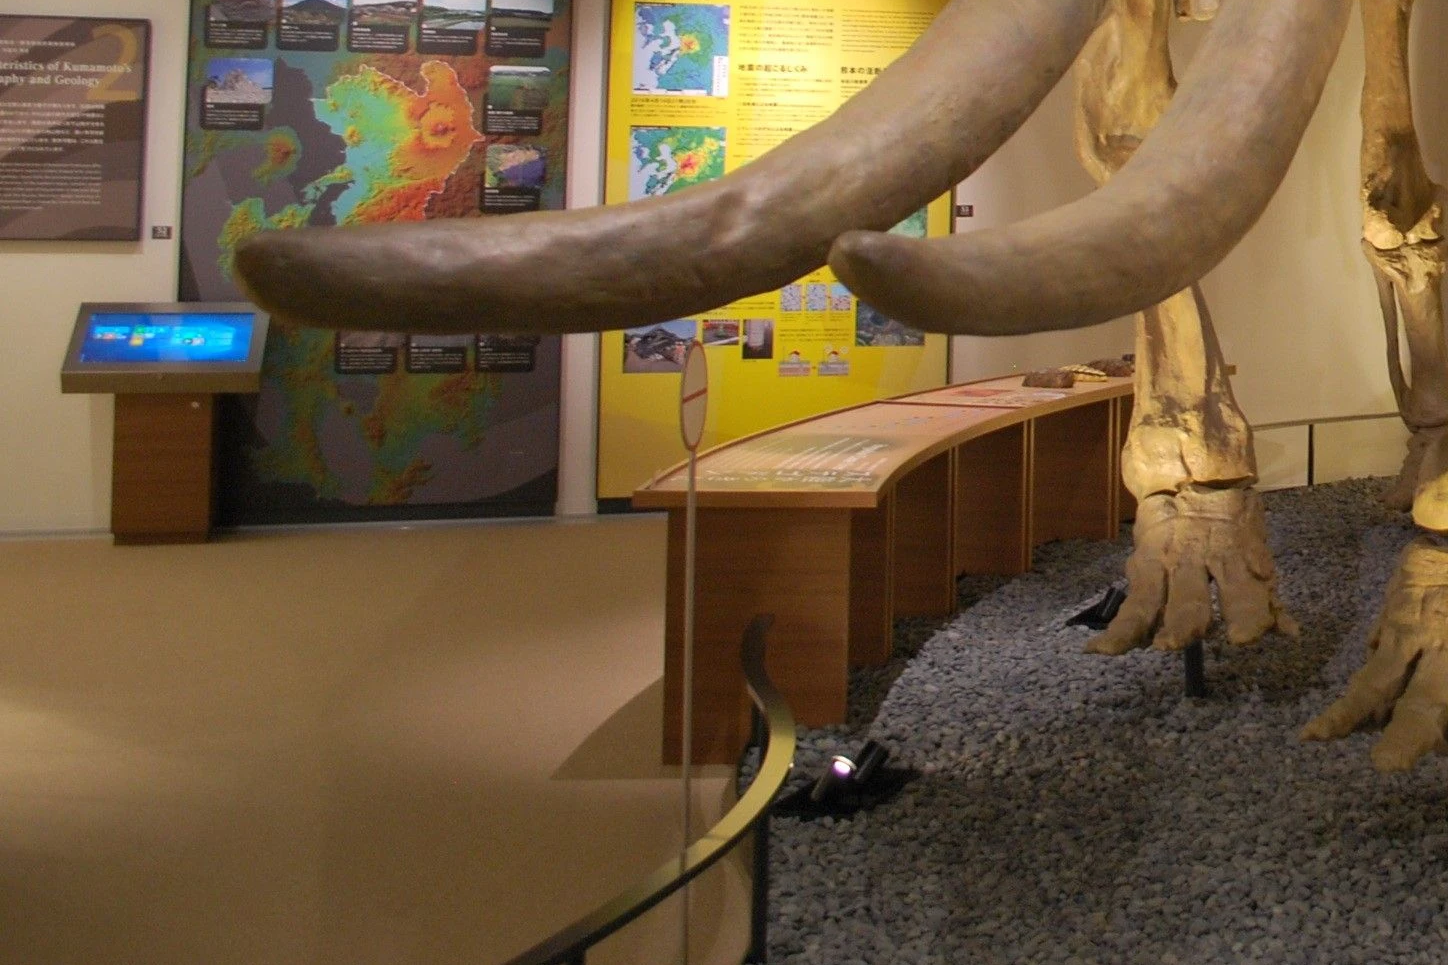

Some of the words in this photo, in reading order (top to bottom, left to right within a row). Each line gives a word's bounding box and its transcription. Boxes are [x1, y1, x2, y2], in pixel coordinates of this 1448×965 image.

[47, 61, 60, 71] of
[63, 62, 132, 73] Kumamoto's
[86, 23, 138, 101] 2
[840, 66, 888, 76] 熊本の活断
[30, 75, 51, 85] and
[55, 76, 101, 87] Geology
